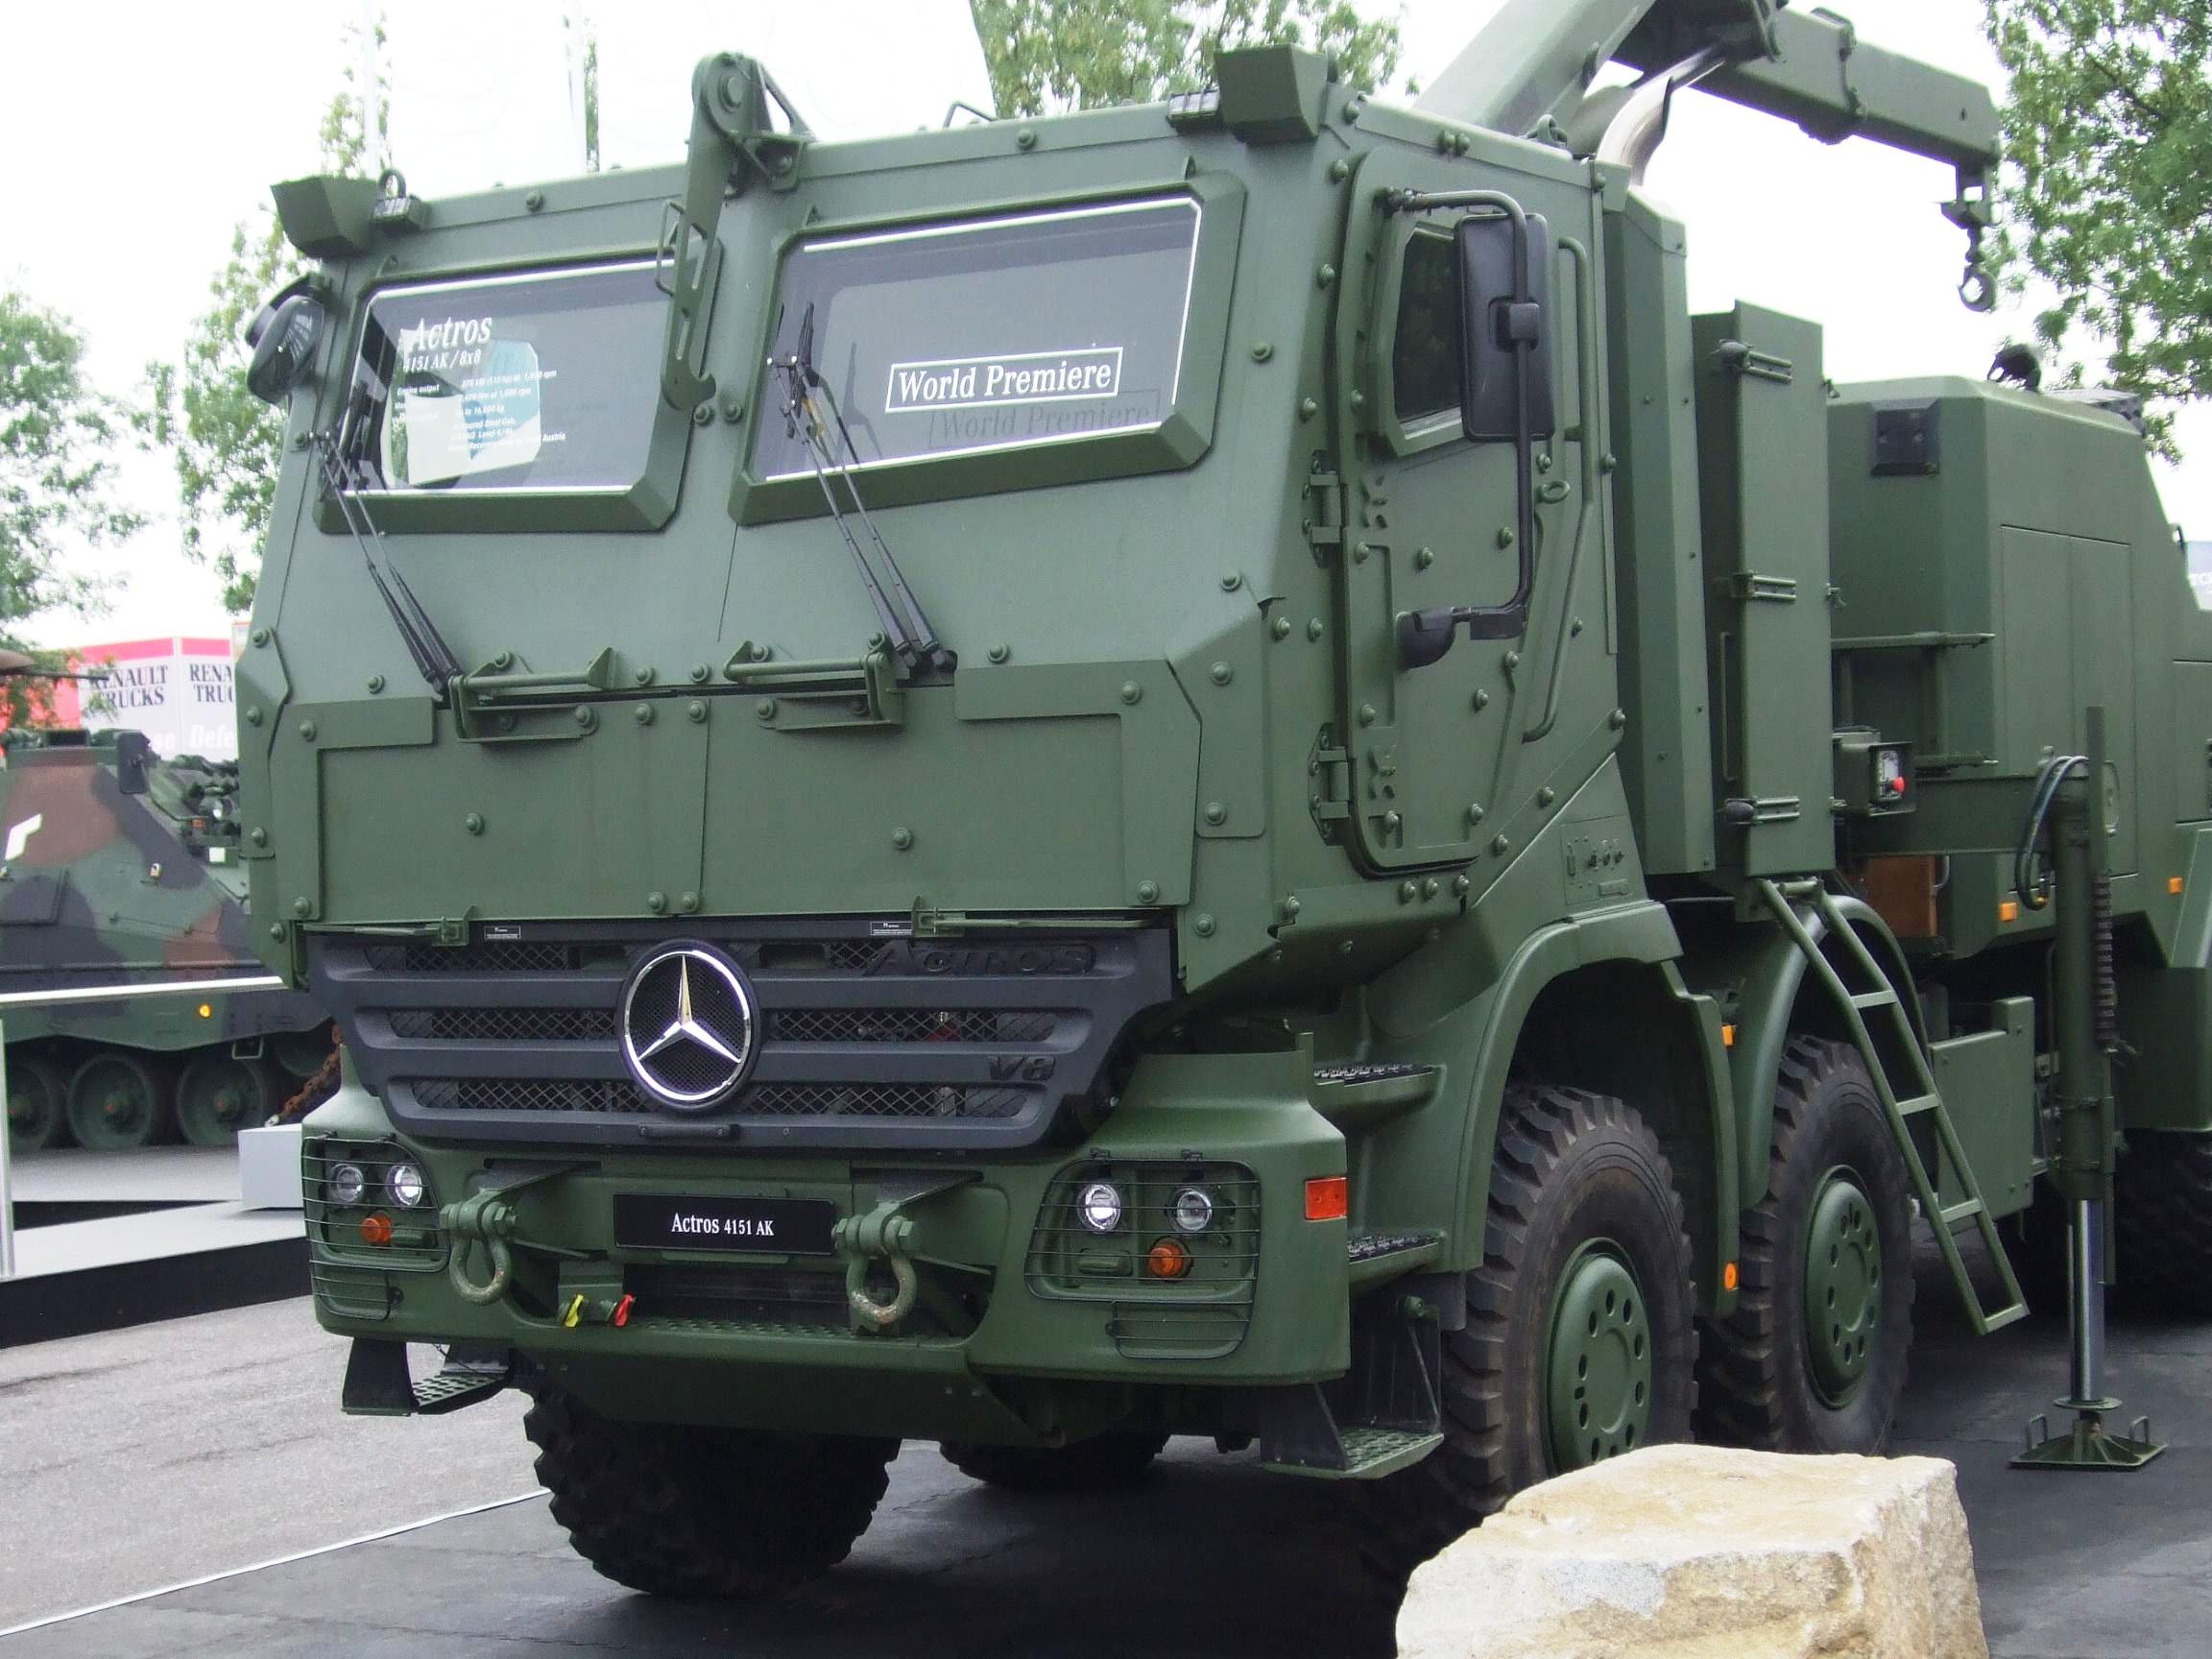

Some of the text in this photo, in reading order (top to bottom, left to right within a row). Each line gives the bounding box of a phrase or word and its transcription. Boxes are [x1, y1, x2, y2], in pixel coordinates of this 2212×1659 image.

[410, 317, 493, 351] Actros
[898, 360, 1112, 403] World Premiere
[941, 402, 1150, 439] World Premiere
[987, 1056, 1055, 1081] V8
[671, 1213, 775, 1236] Actros 4151 AK
